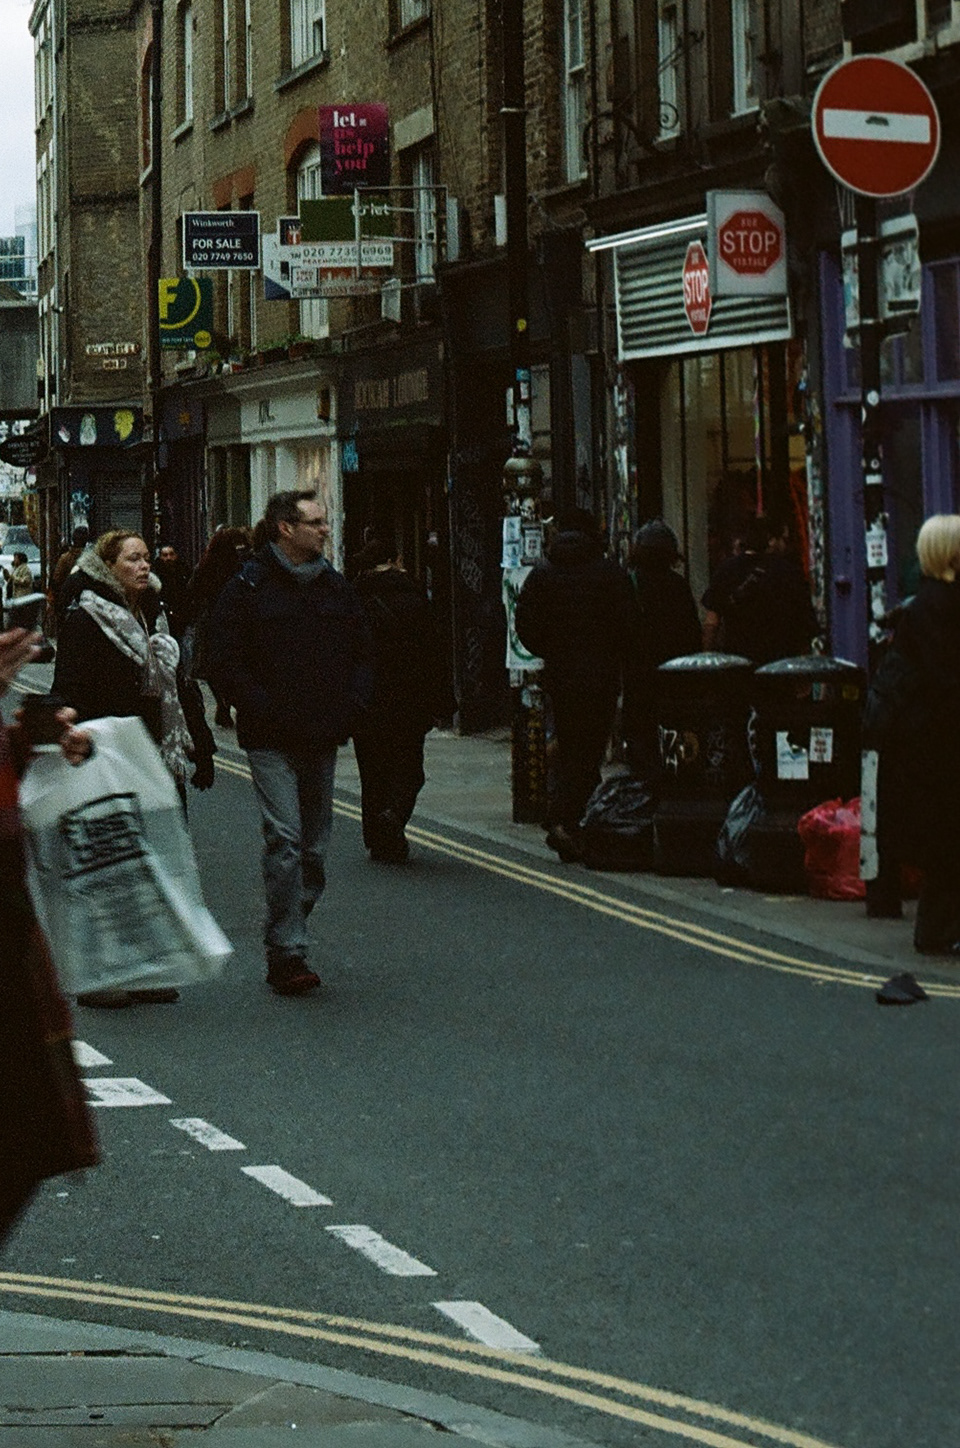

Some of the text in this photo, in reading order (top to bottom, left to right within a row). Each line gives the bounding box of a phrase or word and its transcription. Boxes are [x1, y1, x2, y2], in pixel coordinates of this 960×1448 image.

[333, 110, 356, 128] let
[334, 138, 374, 159] help
[334, 159, 367, 175] you
[192, 219, 235, 228] Winkworth
[192, 238, 241, 249] FOR SALE
[722, 230, 777, 254] STOP
[192, 252, 209, 261] 020
[210, 252, 231, 261] 7749
[303, 247, 325, 257] 020
[685, 269, 709, 305] STOP
